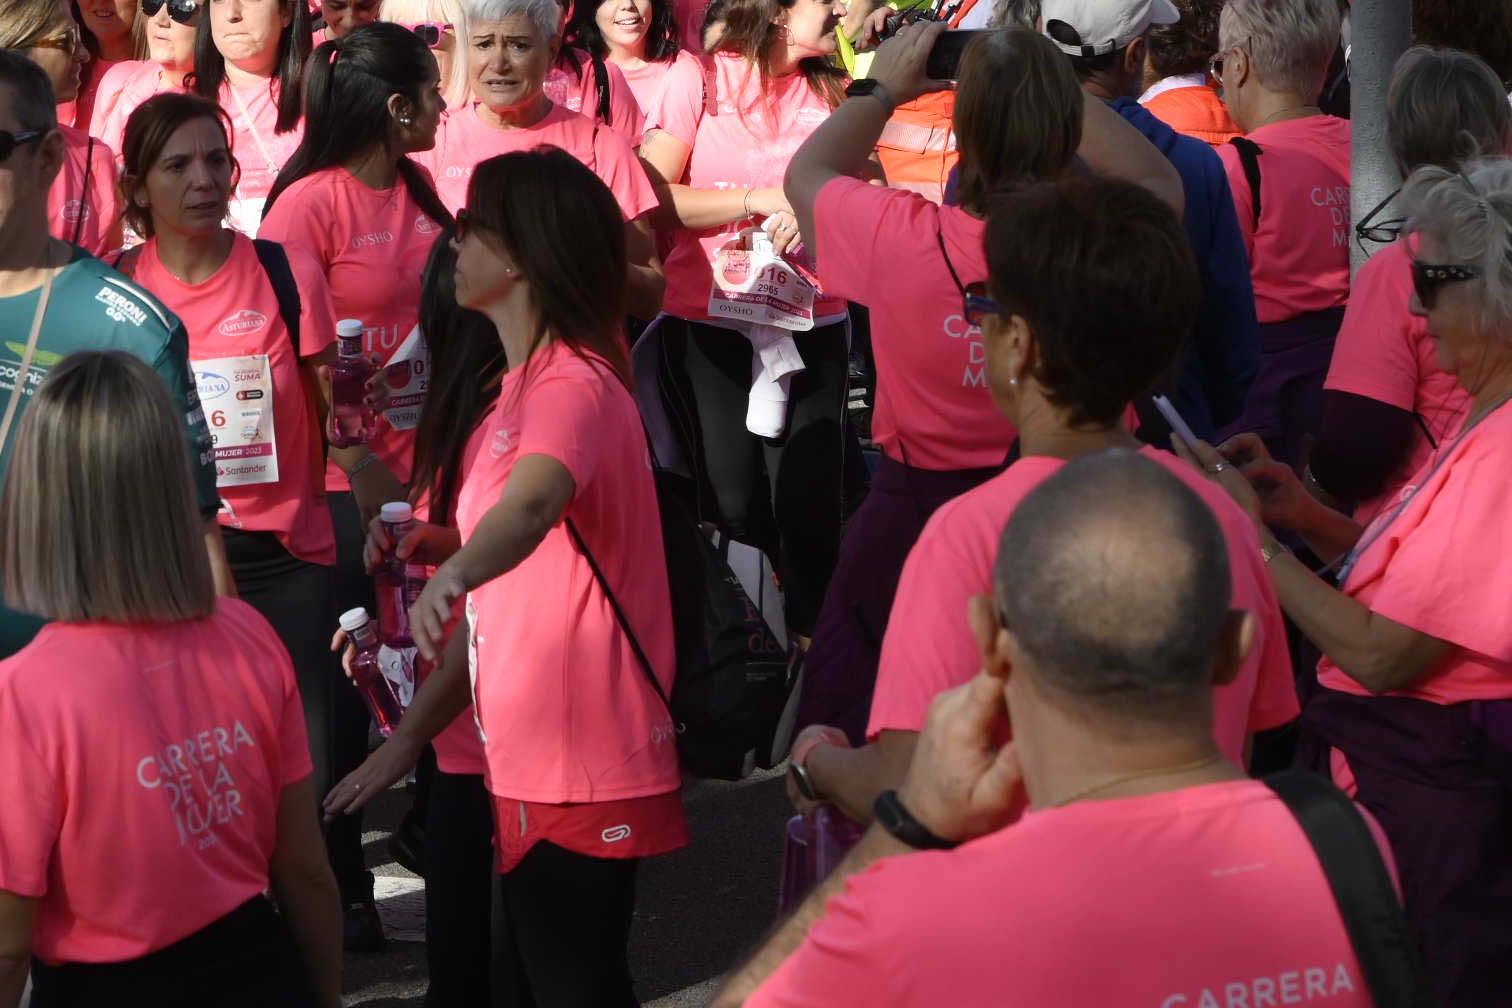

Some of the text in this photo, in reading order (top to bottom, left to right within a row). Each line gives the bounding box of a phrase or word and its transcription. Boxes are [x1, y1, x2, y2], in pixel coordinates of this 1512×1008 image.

[352, 231, 393, 248] OYSHO
[98, 287, 148, 323] PERONI
[719, 304, 753, 316] OYSHO
[222, 318, 265, 333] ASTURIANA
[362, 324, 398, 352] TU
[215, 448, 243, 458] MUJER
[225, 463, 266, 477] Santander
[136, 719, 256, 790] CARRERA
[165, 762, 235, 810] DE LA
[1160, 963, 1355, 1008] CARRERA
